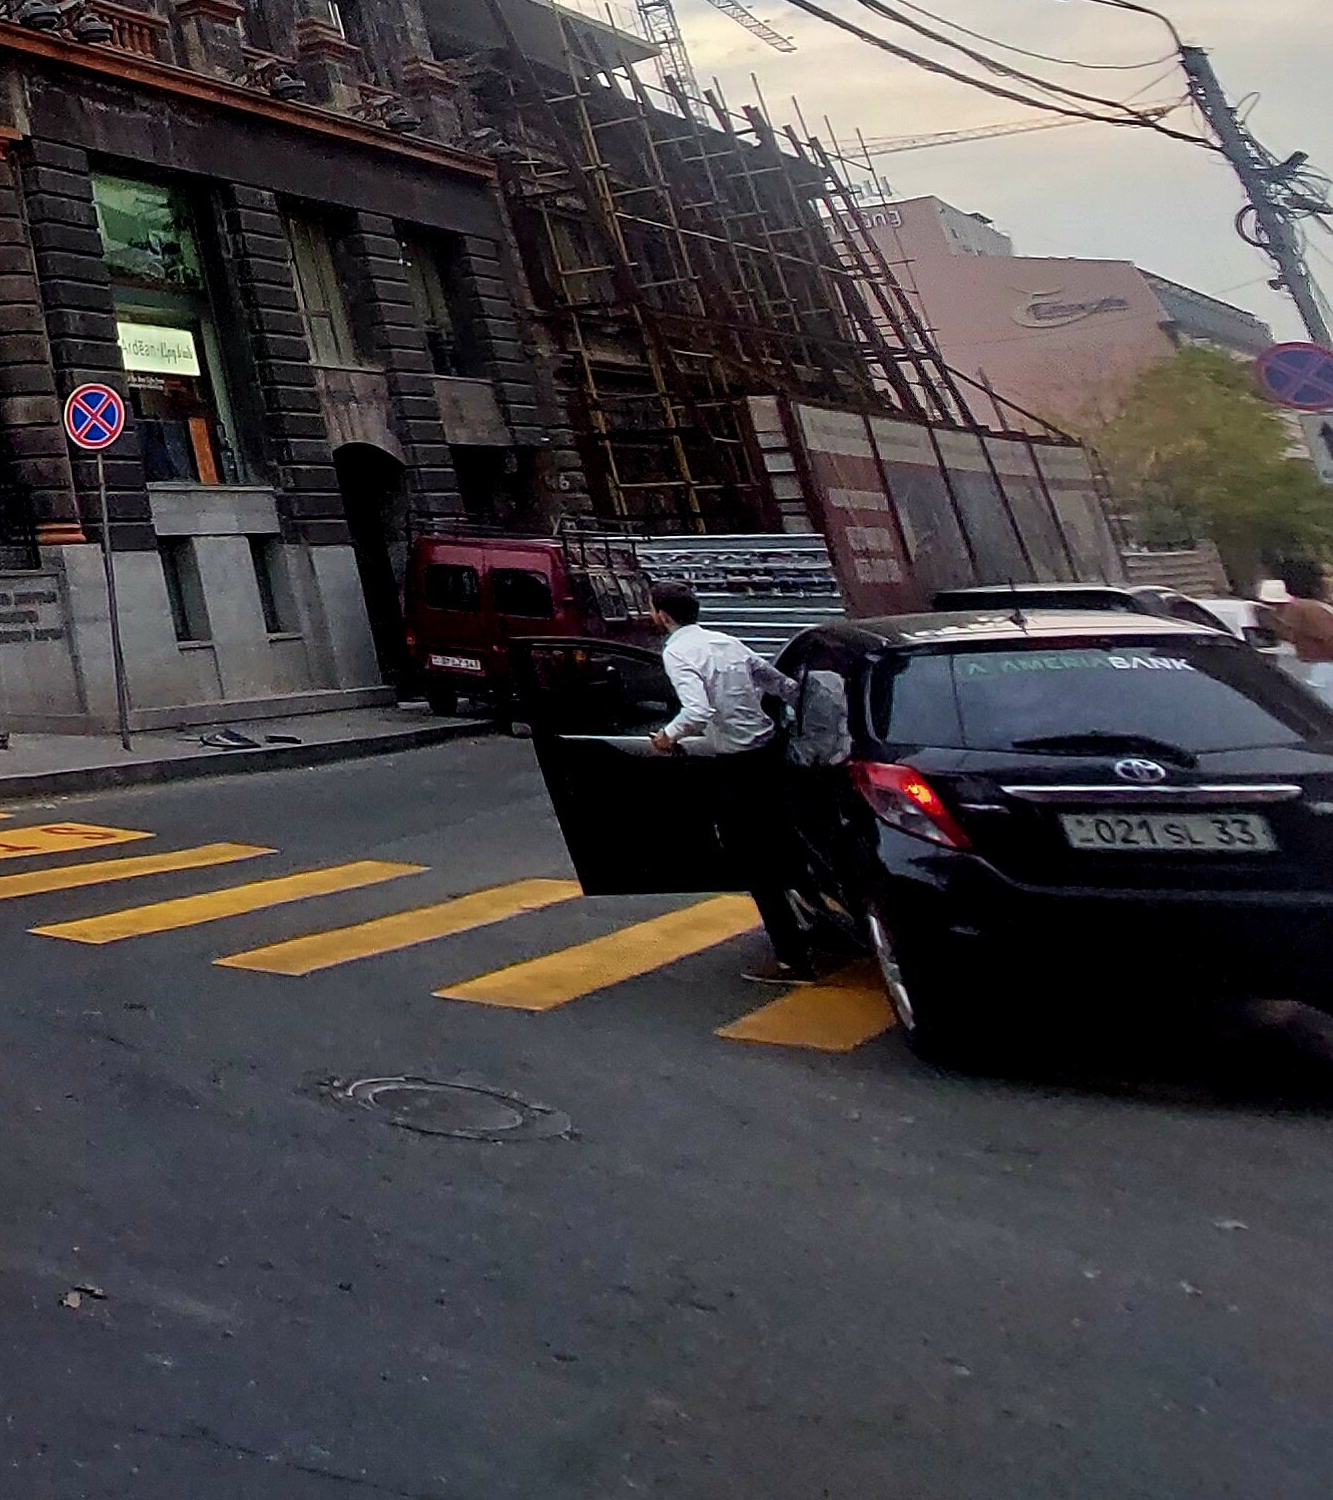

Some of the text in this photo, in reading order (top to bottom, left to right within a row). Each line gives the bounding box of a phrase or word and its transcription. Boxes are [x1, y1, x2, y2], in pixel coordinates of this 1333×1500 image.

[1095, 819, 1157, 845] 021
[1164, 823, 1205, 845] SL
[1212, 819, 1256, 845] 33
